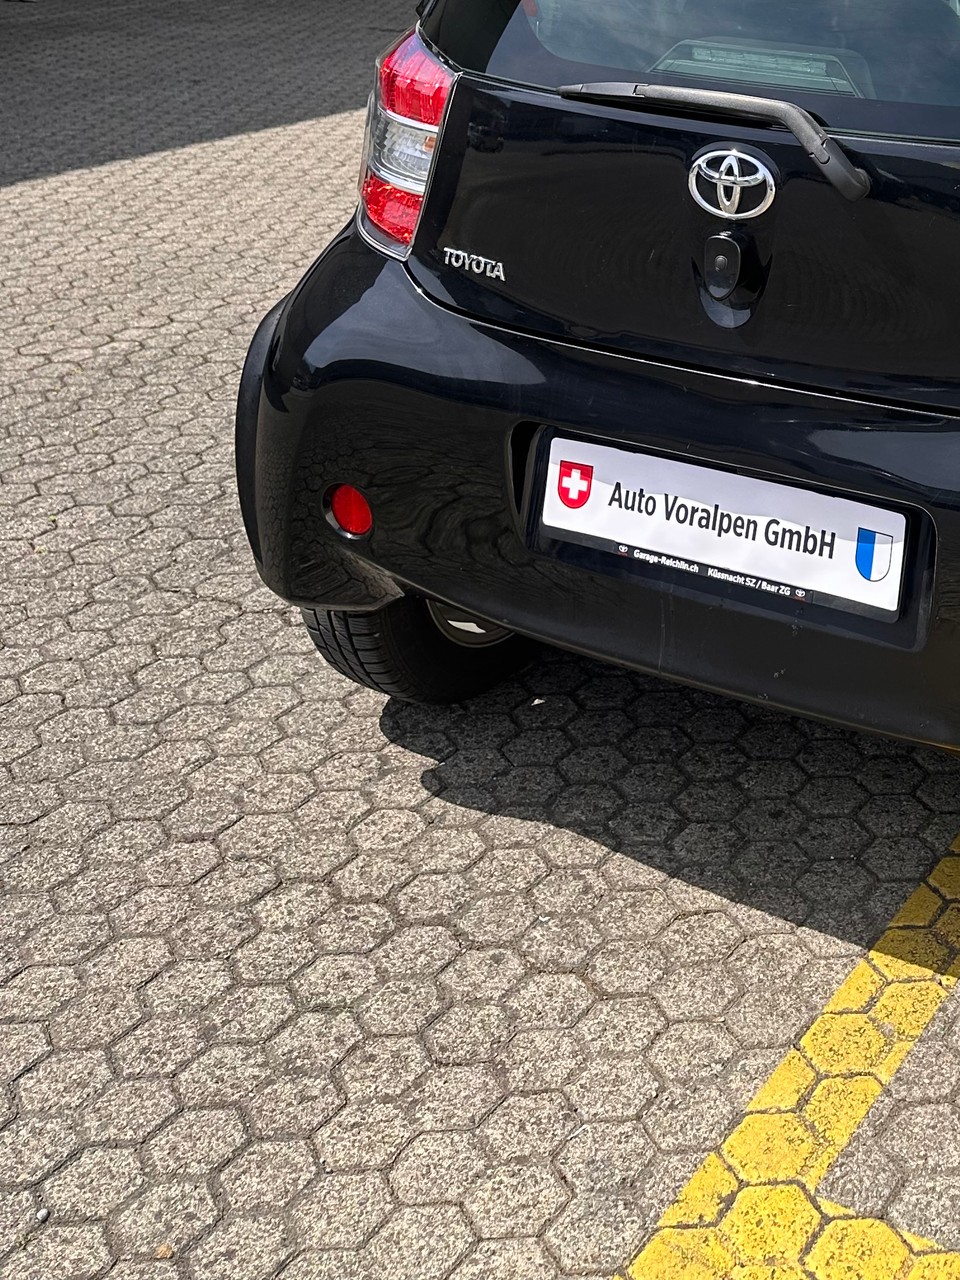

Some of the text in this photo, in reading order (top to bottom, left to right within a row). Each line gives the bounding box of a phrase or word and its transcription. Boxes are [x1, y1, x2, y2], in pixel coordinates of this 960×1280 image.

[443, 247, 506, 281] TOYOTA
[608, 482, 837, 559] Auto Voralpen GmbH
[633, 550, 699, 573] Garage-Reichlin.ch
[708, 568, 745, 585] Küssnacht
[745, 577, 757, 588] SZ
[761, 581, 780, 594] Baar
[779, 585, 791, 597] ZG
